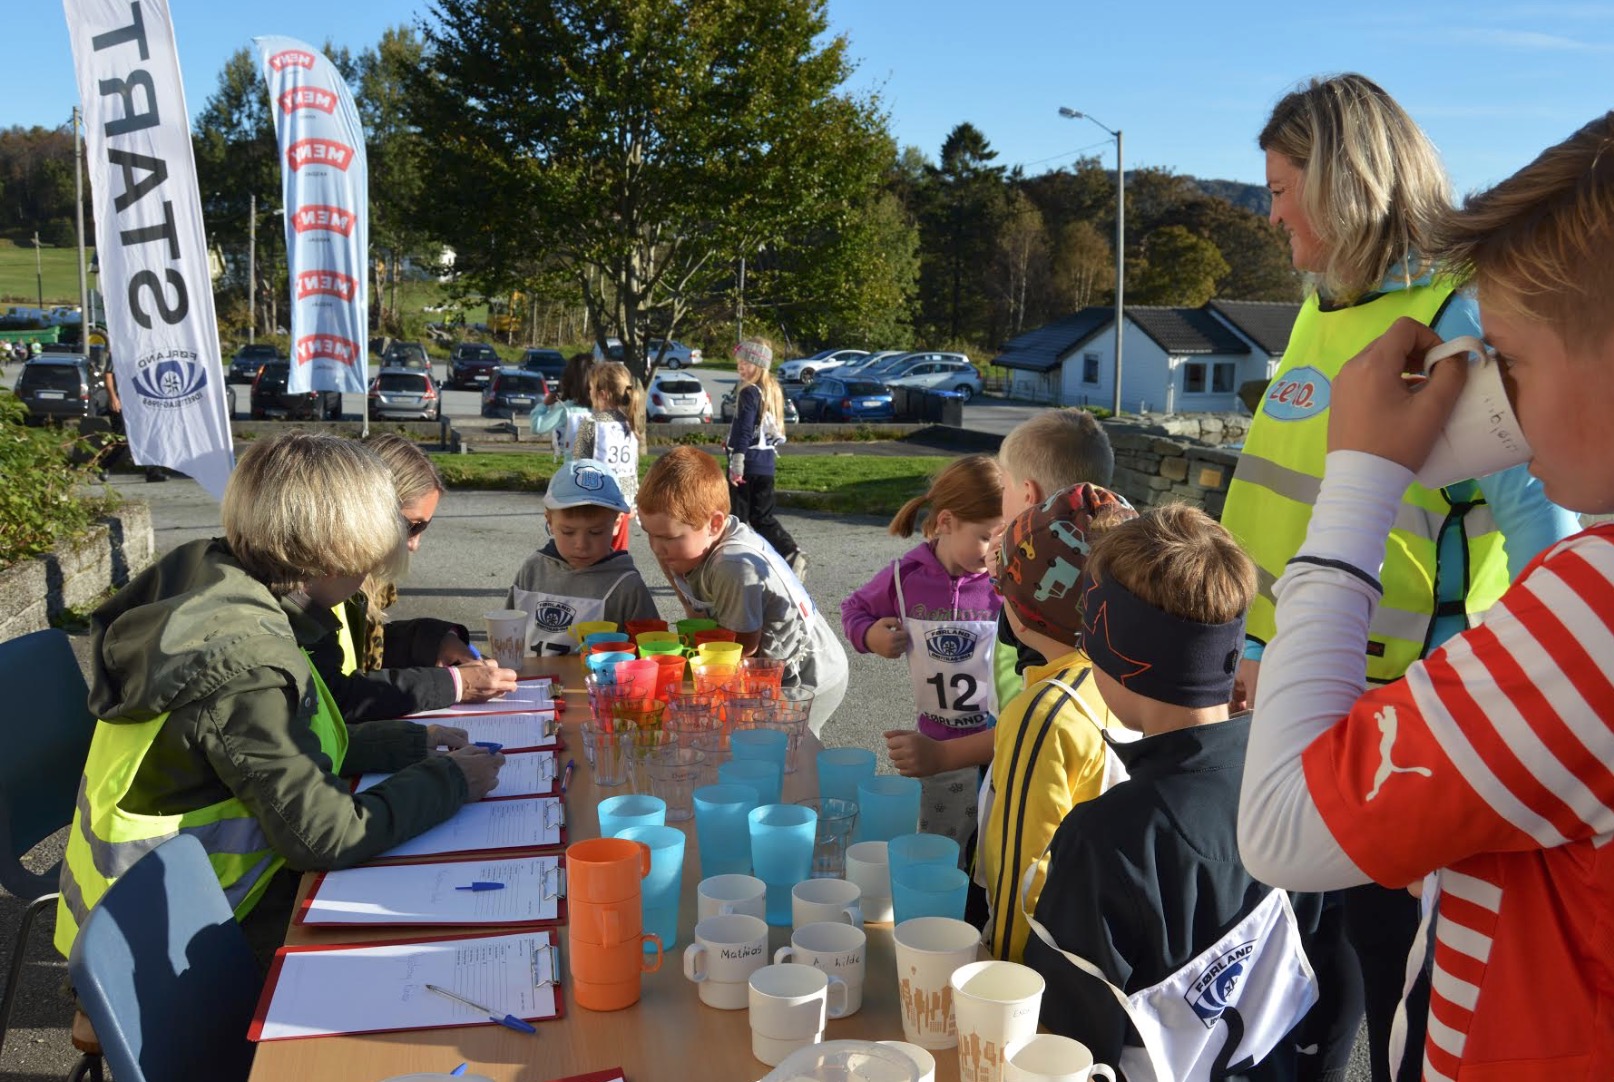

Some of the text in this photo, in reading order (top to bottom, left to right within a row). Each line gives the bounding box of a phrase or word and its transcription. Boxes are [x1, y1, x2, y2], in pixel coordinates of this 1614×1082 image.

[607, 445, 630, 464] 36
[931, 628, 970, 638] FØRLAND
[926, 672, 980, 712] 12
[720, 945, 762, 960] Mathias
[1195, 945, 1253, 993] FØRLAND
[1209, 1006, 1255, 1082] 2
